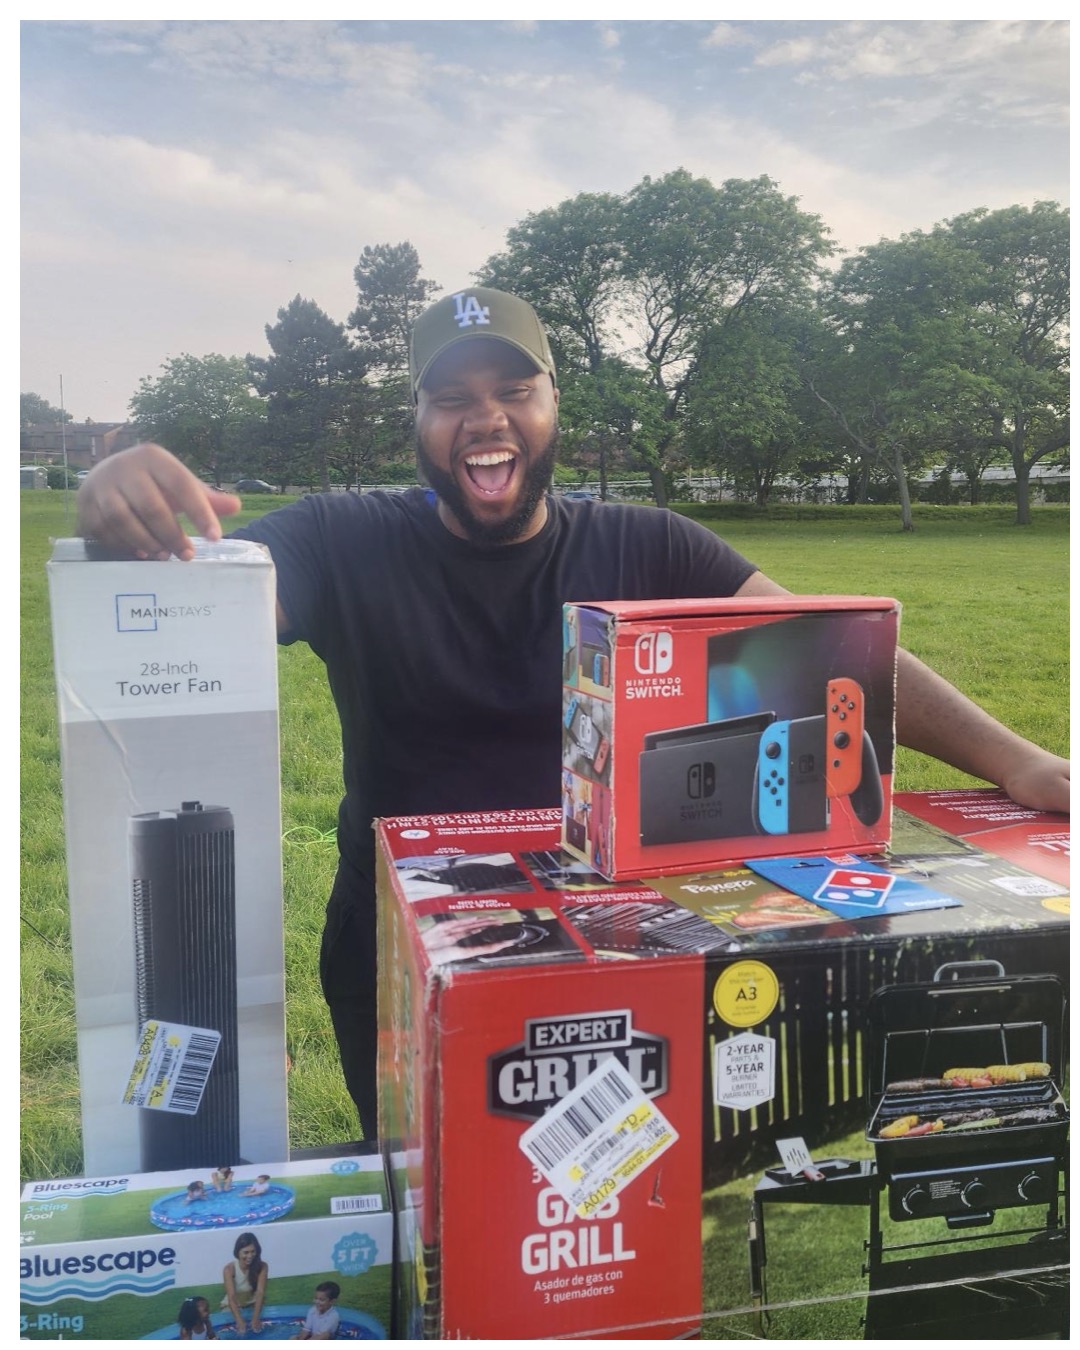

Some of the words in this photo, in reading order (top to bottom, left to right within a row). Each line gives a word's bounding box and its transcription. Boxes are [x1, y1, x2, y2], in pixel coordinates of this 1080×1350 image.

[453, 292, 491, 328] LA
[130, 605, 212, 619] MAINSTAYS
[140, 661, 199, 676] 28-Inch
[116, 681, 180, 697] Tower
[188, 677, 222, 693] Fan
[625, 677, 682, 687] NINTENDO
[625, 685, 681, 699] SWITCH
[680, 808, 722, 821] SWITCH
[735, 986, 758, 1001] A3
[535, 1019, 622, 1047] EXPERT
[138, 1030, 153, 1055] A0428
[726, 1043, 765, 1056] 2-YEAR
[498, 1048, 657, 1105] GRIL
[726, 1062, 765, 1075] 5-YEAR
[731, 1082, 758, 1091] LIMITED
[33, 1177, 130, 1194] Bluescape
[583, 1178, 617, 1213] A0179
[23, 1211, 54, 1222] Pool
[337, 1251, 348, 1263] 5
[350, 1247, 372, 1262] FT
[521, 1222, 636, 1275] GRILL
[20, 1247, 176, 1279] Bluescape
[534, 1276, 570, 1292] Asador
[571, 1274, 584, 1286] de
[586, 1272, 604, 1286] gas
[605, 1270, 623, 1281] con
[544, 1293, 551, 1304] 3
[553, 1284, 615, 1304] quemadores
